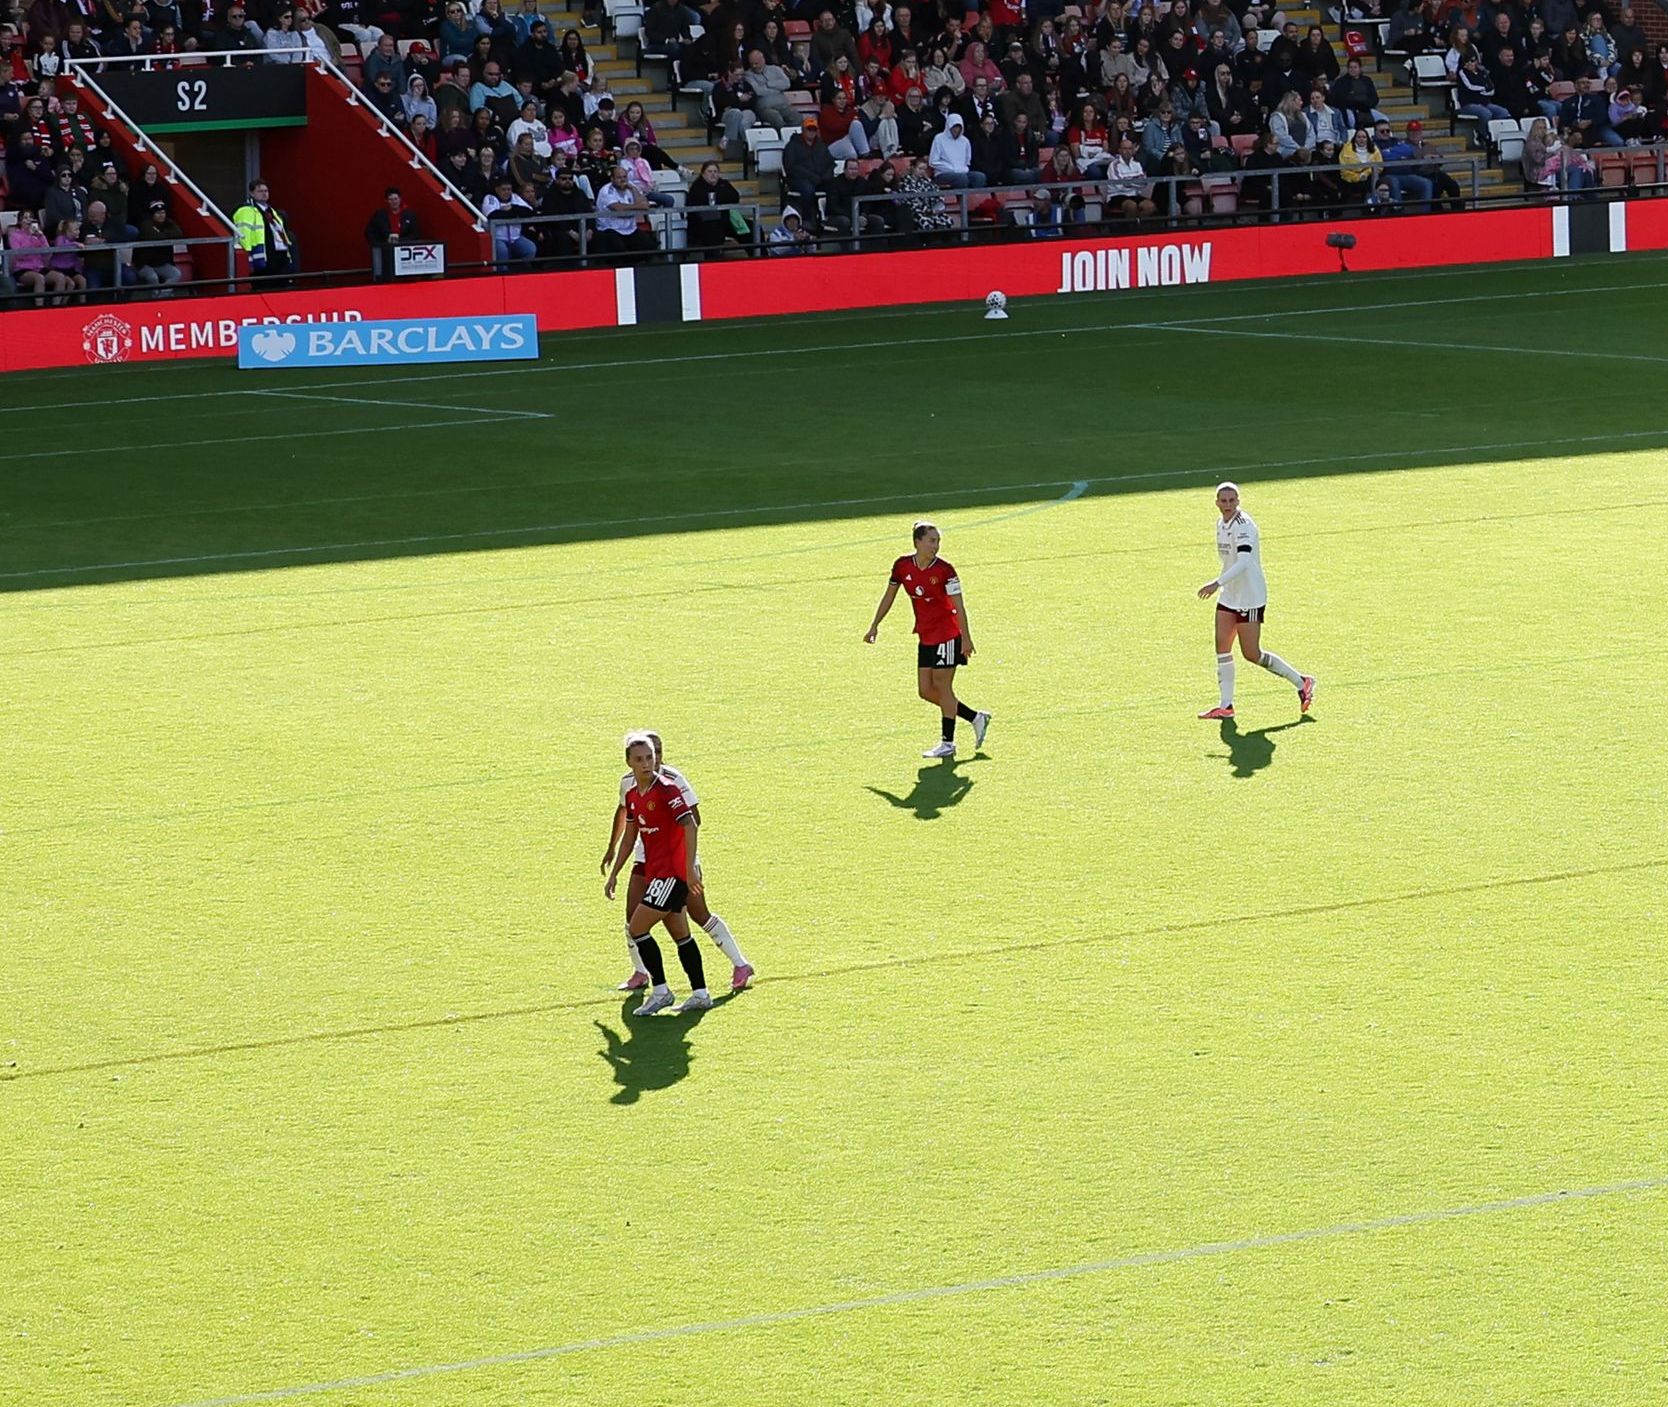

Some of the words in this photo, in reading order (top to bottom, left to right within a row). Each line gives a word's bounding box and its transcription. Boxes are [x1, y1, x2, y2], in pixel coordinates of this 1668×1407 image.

[177, 80, 208, 111] S2
[1057, 248, 1130, 294] JOIN
[1137, 242, 1212, 288] NOW
[307, 323, 524, 356] BARCLAYS
[937, 643, 946, 659] 4
